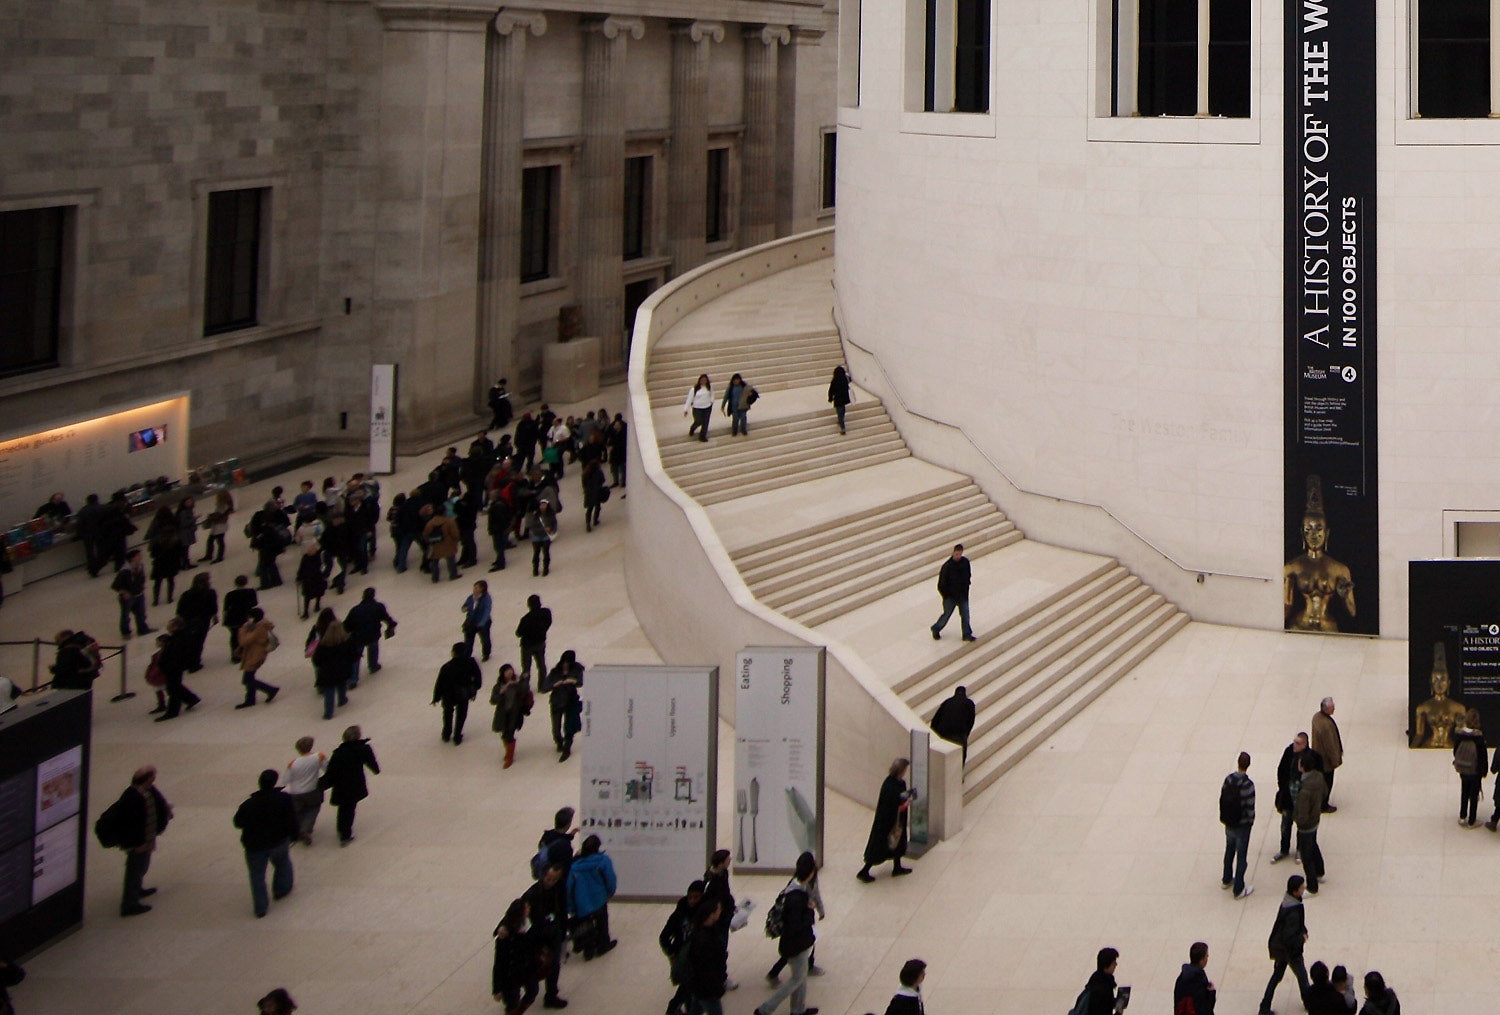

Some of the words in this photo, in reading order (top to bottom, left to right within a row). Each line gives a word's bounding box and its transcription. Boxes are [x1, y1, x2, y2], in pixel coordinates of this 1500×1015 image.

[1303, 41, 1329, 106] THE
[1303, 113, 1329, 163] OF
[1303, 165, 1330, 316] HISTORY
[1342, 196, 1357, 285] OBJECTS
[1342, 288, 1357, 324] 100
[1303, 325, 1329, 349] A
[1342, 327, 1357, 348] IN
[741, 658, 753, 690] Eating
[781, 658, 794, 705] Shopping
[669, 718, 677, 738] Upper
